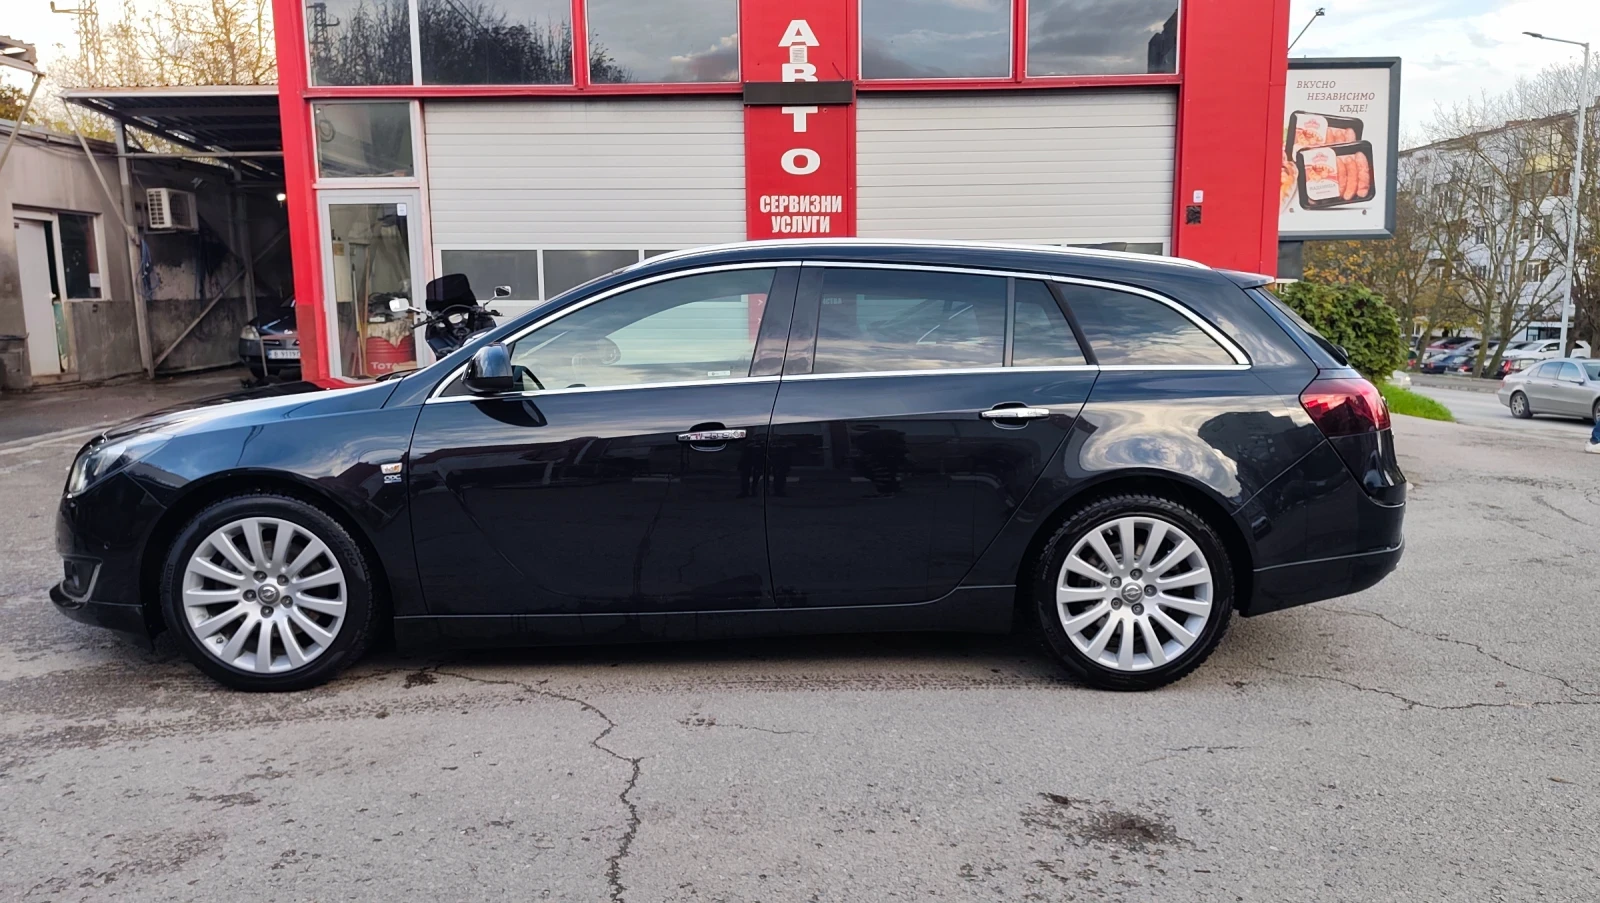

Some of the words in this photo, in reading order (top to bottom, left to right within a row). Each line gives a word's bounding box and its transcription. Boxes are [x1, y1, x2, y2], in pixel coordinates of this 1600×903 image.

[1296, 80, 1336, 89] ВКУСНО
[778, 19, 821, 175] АВТО
[1307, 92, 1376, 101] НЕЗАВИСИМО
[1339, 104, 1368, 114] КЪДЕ!
[759, 195, 842, 214] СЕРВИЗНИ
[771, 215, 830, 234] УСЛУГИ
